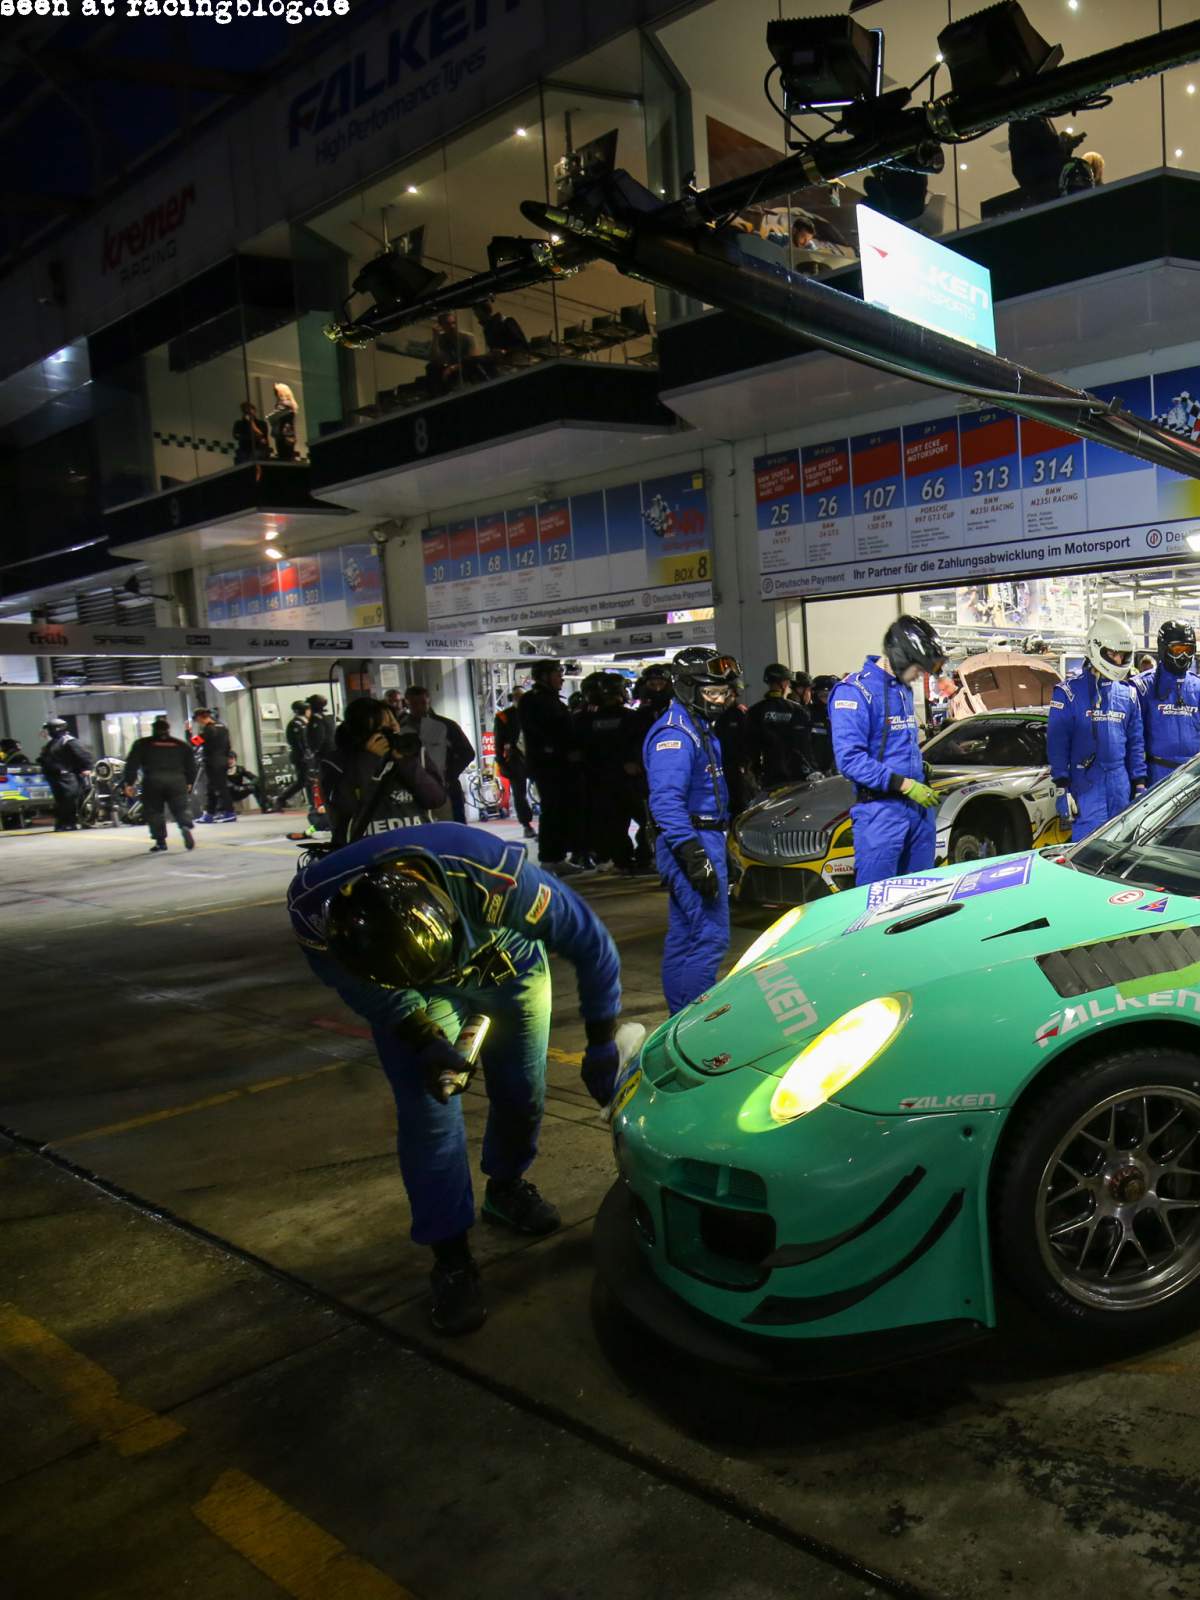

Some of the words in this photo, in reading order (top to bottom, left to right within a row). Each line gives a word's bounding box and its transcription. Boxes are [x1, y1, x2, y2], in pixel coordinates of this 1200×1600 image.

[971, 465, 1009, 493] 313
[1032, 454, 1074, 483] 314
[863, 485, 896, 510] 107
[921, 477, 945, 501] 66
[770, 503, 790, 526] 25
[817, 495, 838, 518] 26
[515, 549, 535, 568] 142
[547, 543, 568, 562] 152
[774, 575, 809, 590] Deutsche
[810, 573, 845, 587] Payment
[853, 568, 866, 580] Ihr
[868, 563, 901, 578] Partner
[904, 561, 919, 574] für
[920, 559, 935, 572] die
[937, 544, 1045, 570] Zahlungsabwicklung
[1048, 544, 1062, 557] im
[1065, 536, 1131, 556] Motorsport
[459, 560, 472, 577] 13
[674, 568, 695, 583] BOX
[697, 556, 708, 579] 8
[425, 638, 449, 649] VITAL
[899, 1093, 997, 1110] FALKEN
